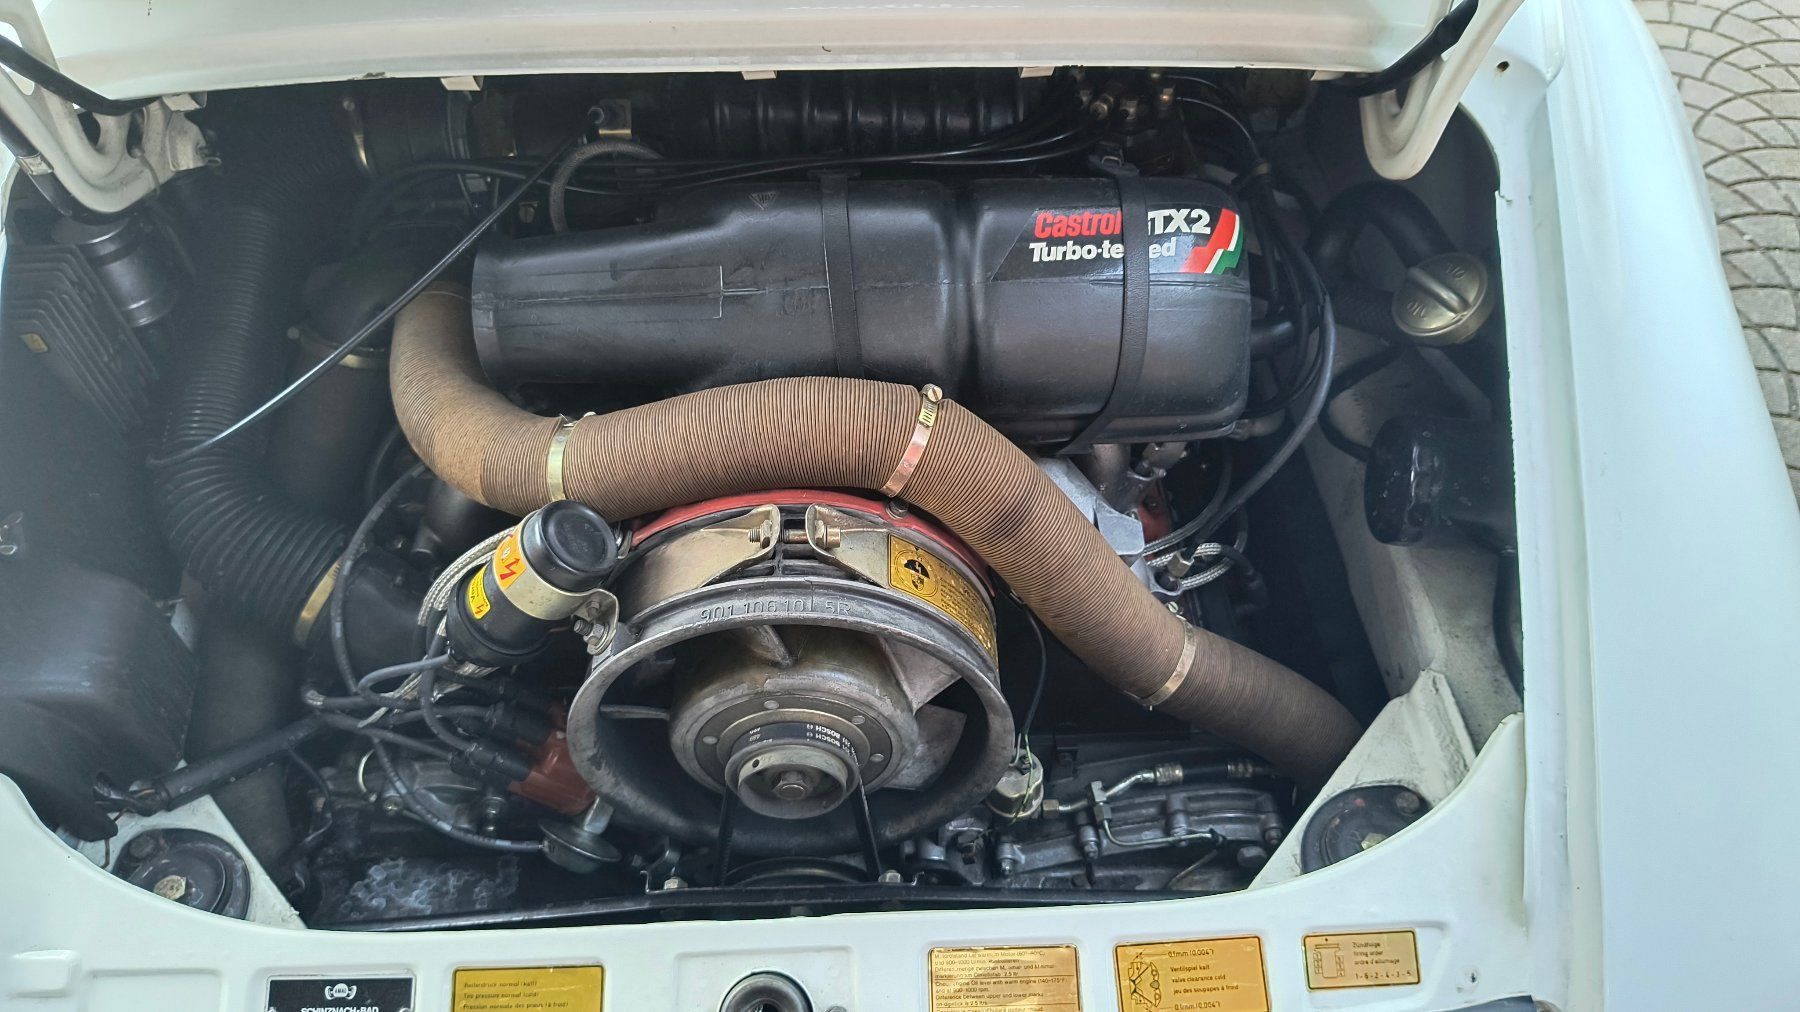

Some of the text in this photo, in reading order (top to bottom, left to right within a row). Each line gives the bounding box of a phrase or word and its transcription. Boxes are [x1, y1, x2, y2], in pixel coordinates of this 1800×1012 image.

[1034, 208, 1211, 238] Castrol TX2
[700, 604, 734, 621] 901
[743, 600, 777, 615] 106
[815, 725, 841, 739] BOSCH
[815, 733, 841, 747] BOSCH
